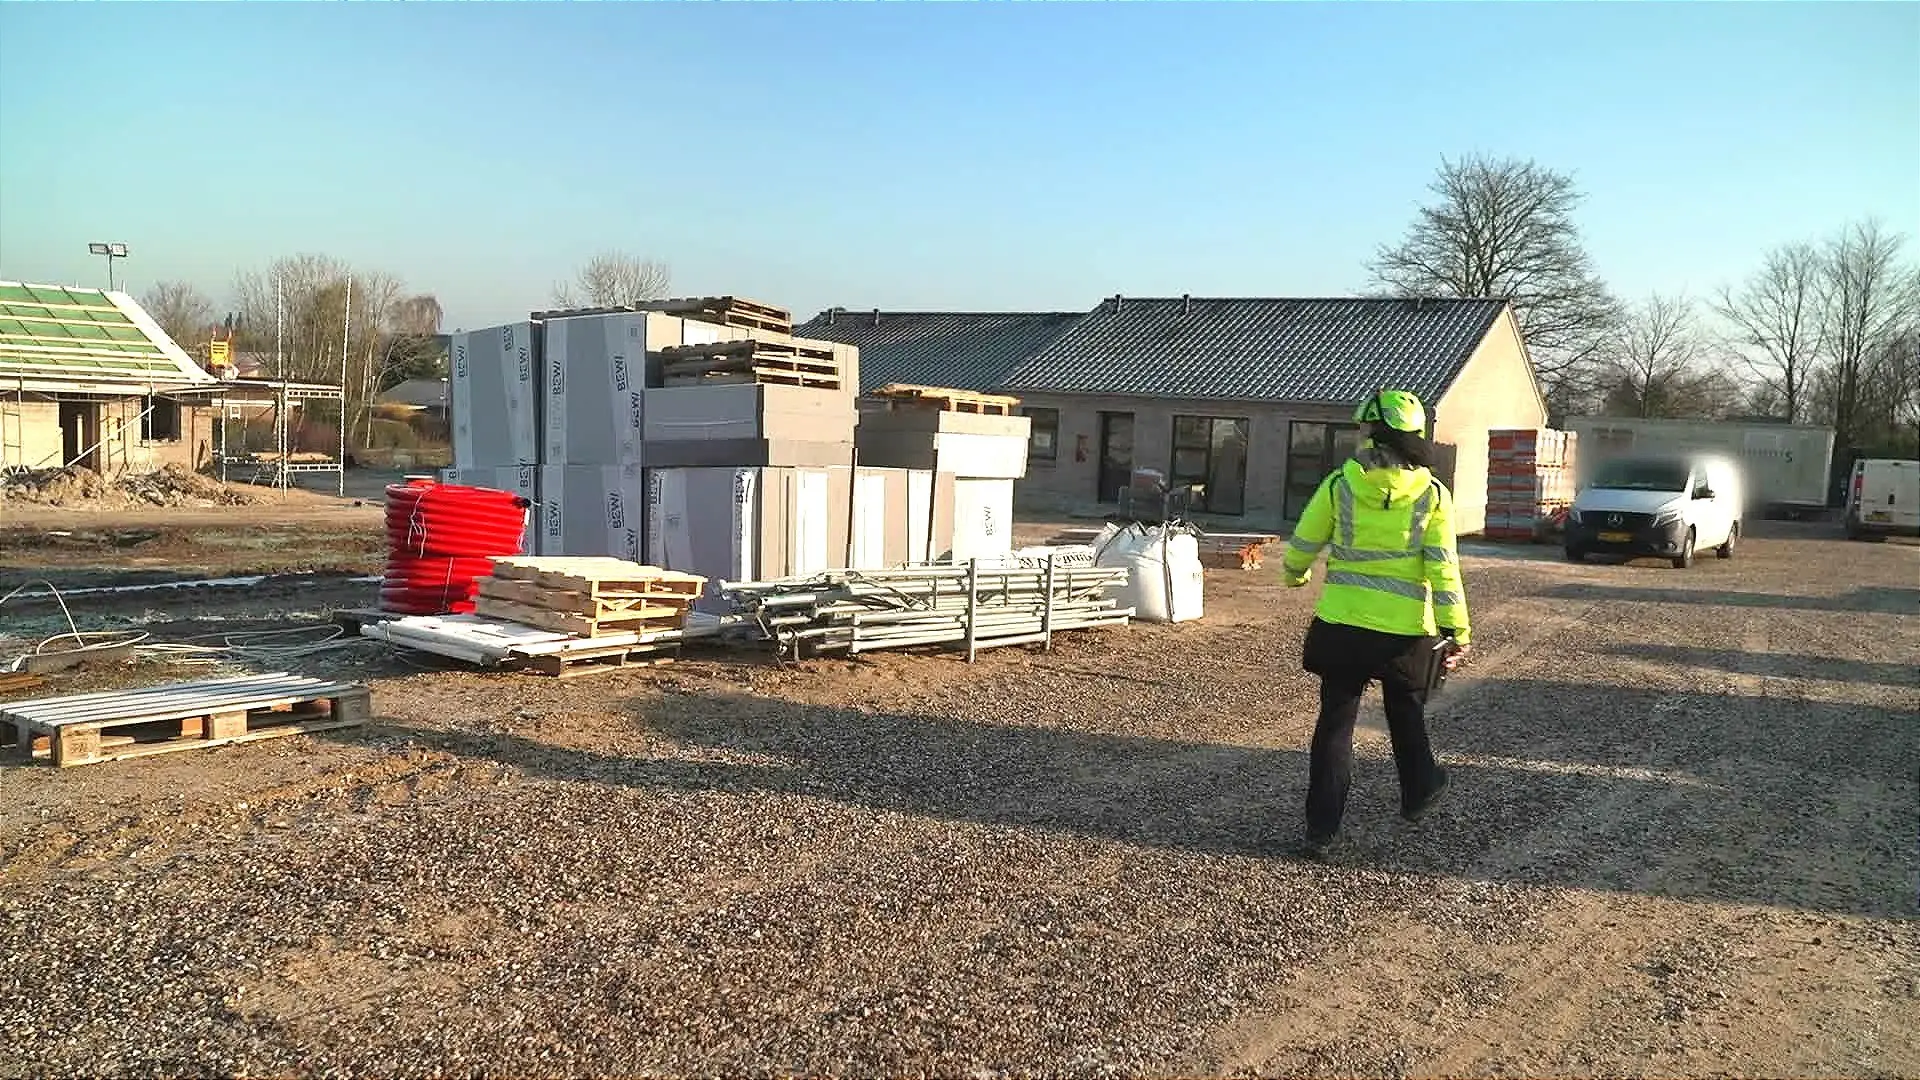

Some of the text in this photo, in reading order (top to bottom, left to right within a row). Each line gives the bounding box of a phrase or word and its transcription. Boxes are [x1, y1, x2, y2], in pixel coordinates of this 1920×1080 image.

[519, 347, 529, 381] BEWI
[552, 360, 563, 395] BEWI
[614, 355, 627, 392] BEWI
[549, 501, 560, 536] BEWI
[609, 491, 623, 529] BEWI
